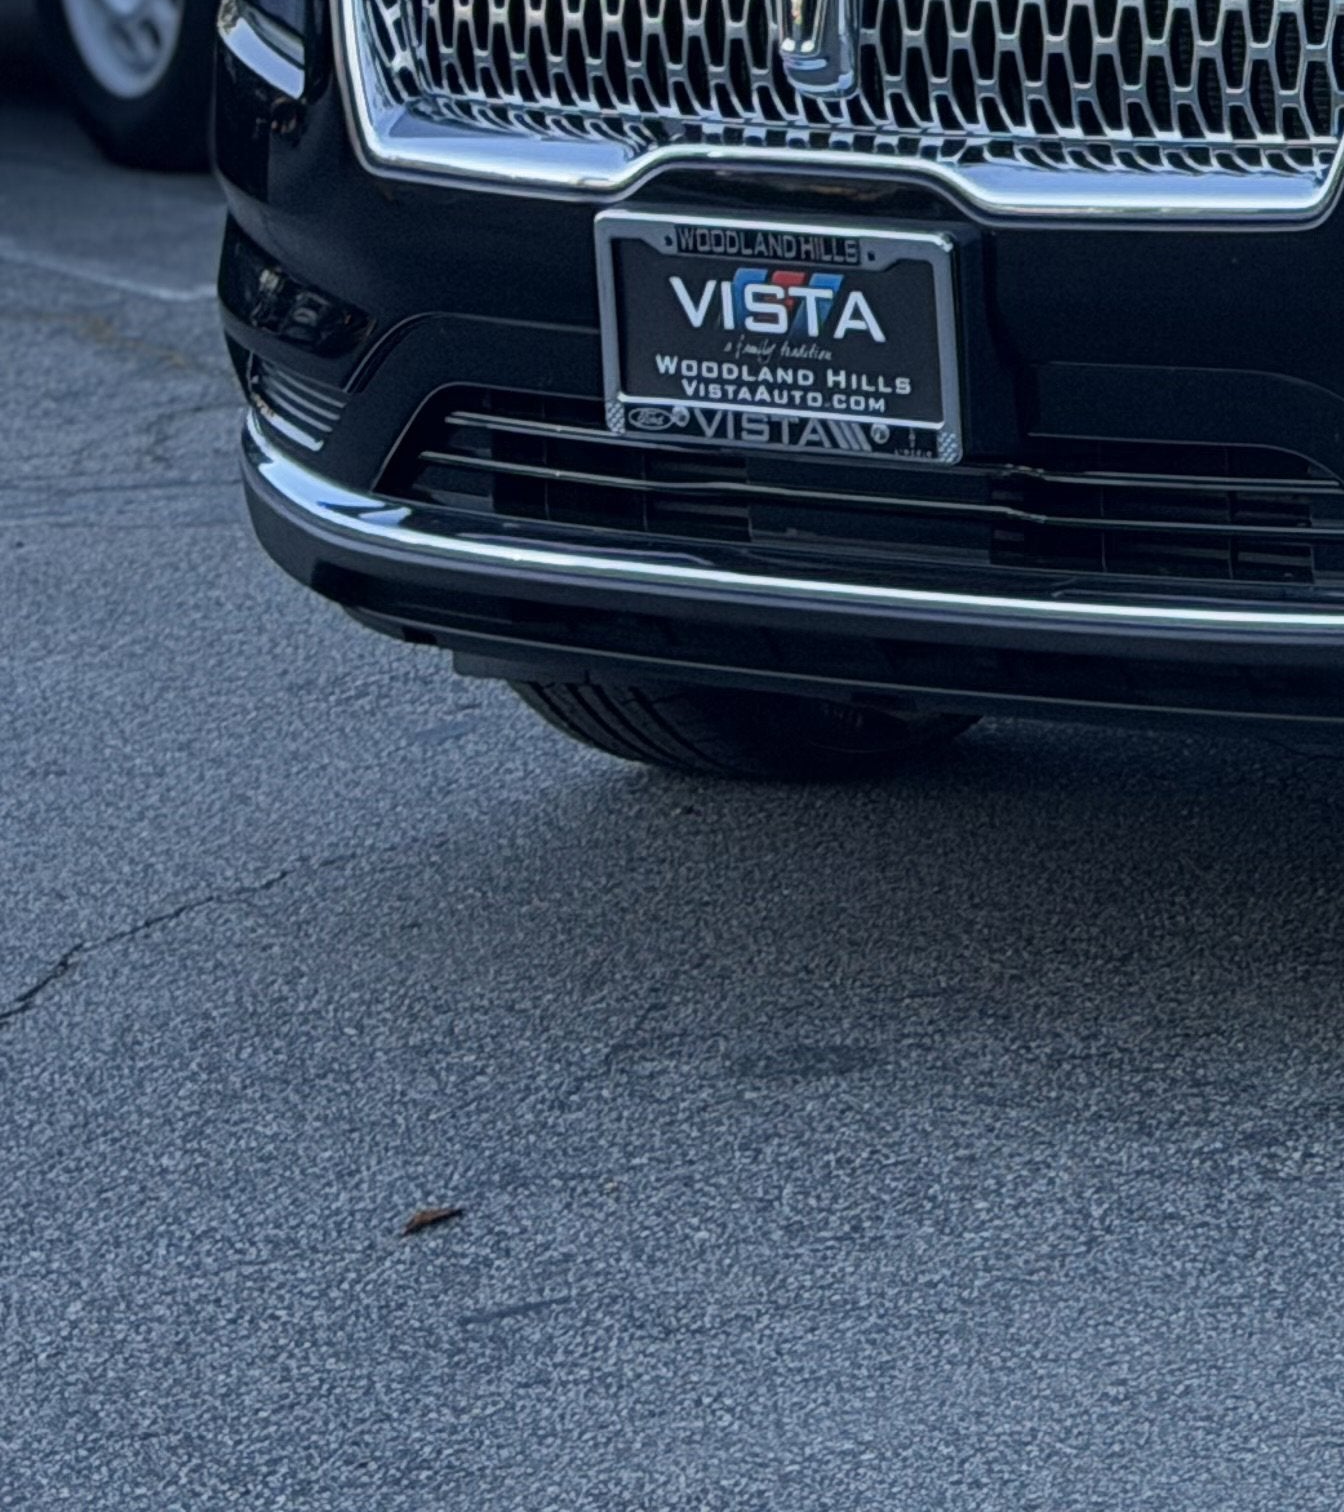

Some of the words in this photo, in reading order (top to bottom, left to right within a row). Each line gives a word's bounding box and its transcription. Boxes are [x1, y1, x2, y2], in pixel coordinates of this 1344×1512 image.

[678, 228, 797, 259] WOODLAND
[799, 237, 860, 264] HILLS
[668, 276, 887, 343] VISTA
[780, 339, 833, 362] tradition
[655, 354, 815, 385] WOODLAND
[826, 368, 912, 395] HILLS
[693, 408, 836, 449] VISTA
